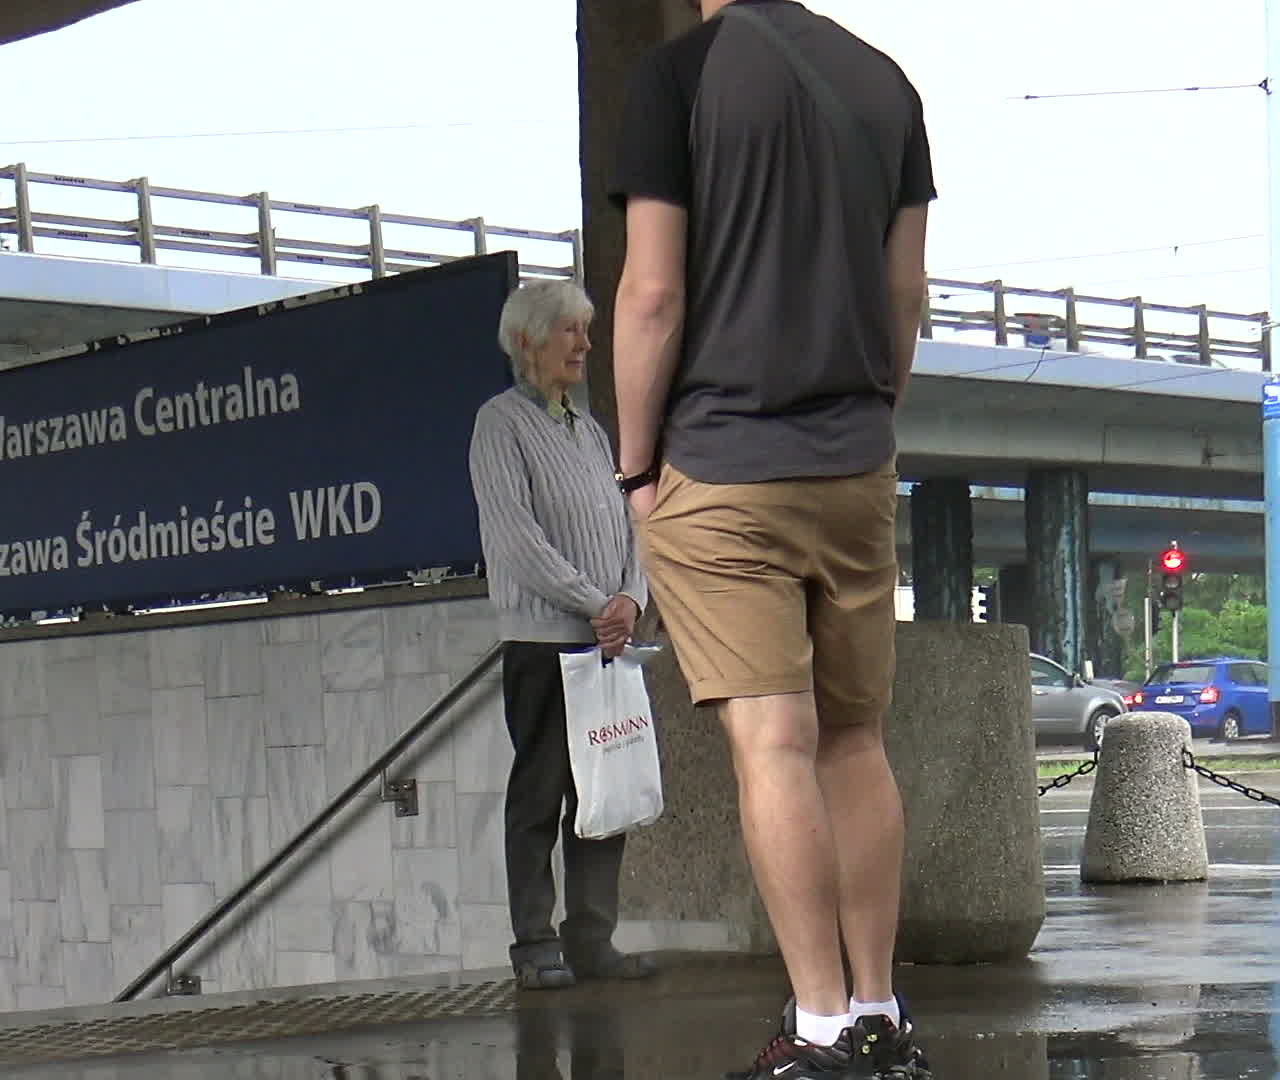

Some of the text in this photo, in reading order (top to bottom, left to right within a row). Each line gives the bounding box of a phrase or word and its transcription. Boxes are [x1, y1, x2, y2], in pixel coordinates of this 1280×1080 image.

[134, 365, 300, 436] Centralna
[76, 495, 275, 567] Śródmieście
[288, 482, 382, 541] WKD
